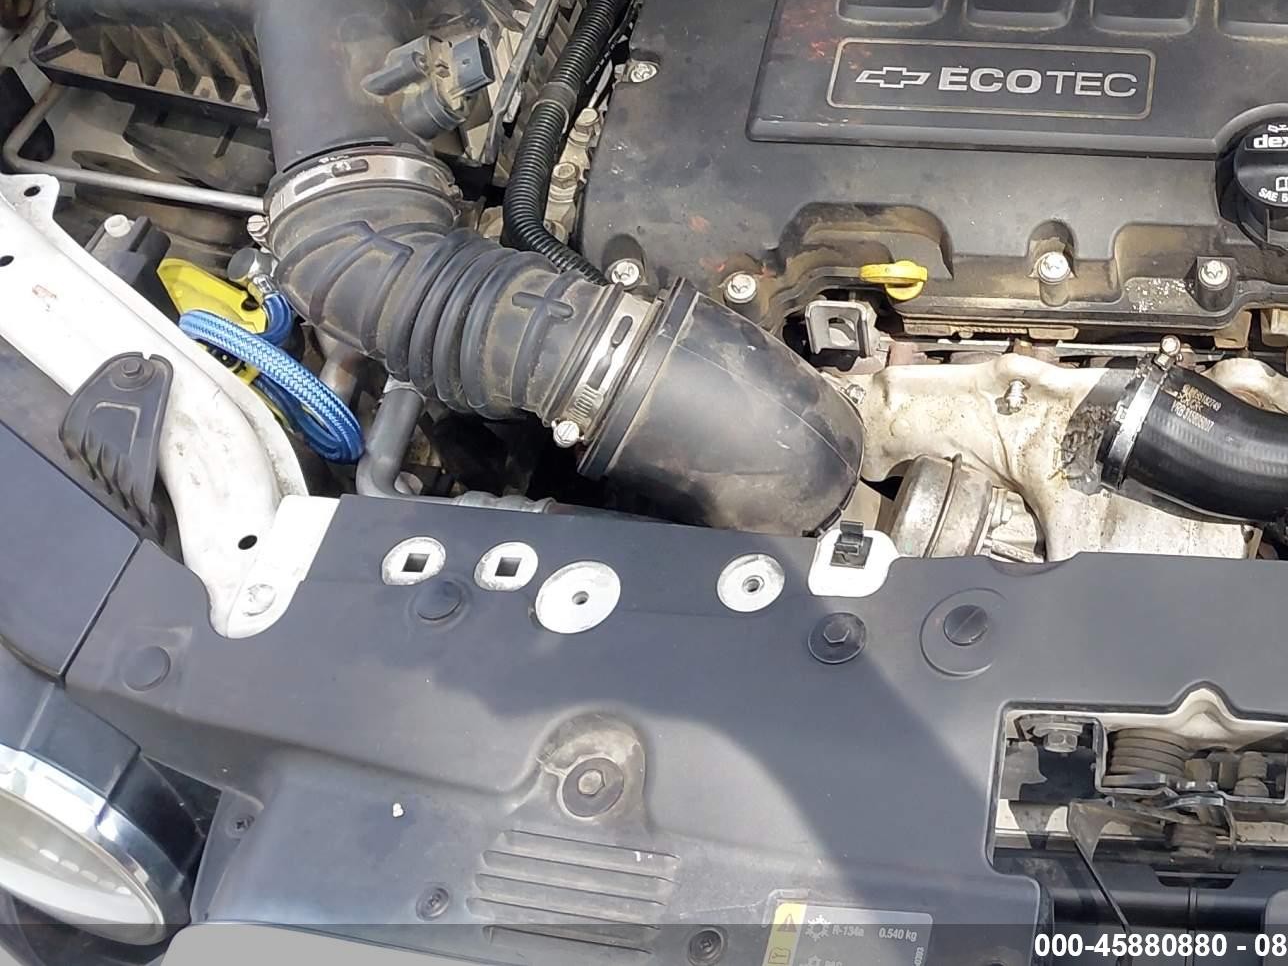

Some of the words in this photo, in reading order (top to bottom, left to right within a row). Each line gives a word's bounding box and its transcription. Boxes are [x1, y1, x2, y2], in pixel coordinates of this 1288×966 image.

[937, 66, 1138, 97] ECOTEC
[1258, 186, 1278, 202] SAE
[831, 924, 865, 937] R-134a
[878, 928, 904, 940] 0.540
[905, 931, 918, 942] kg
